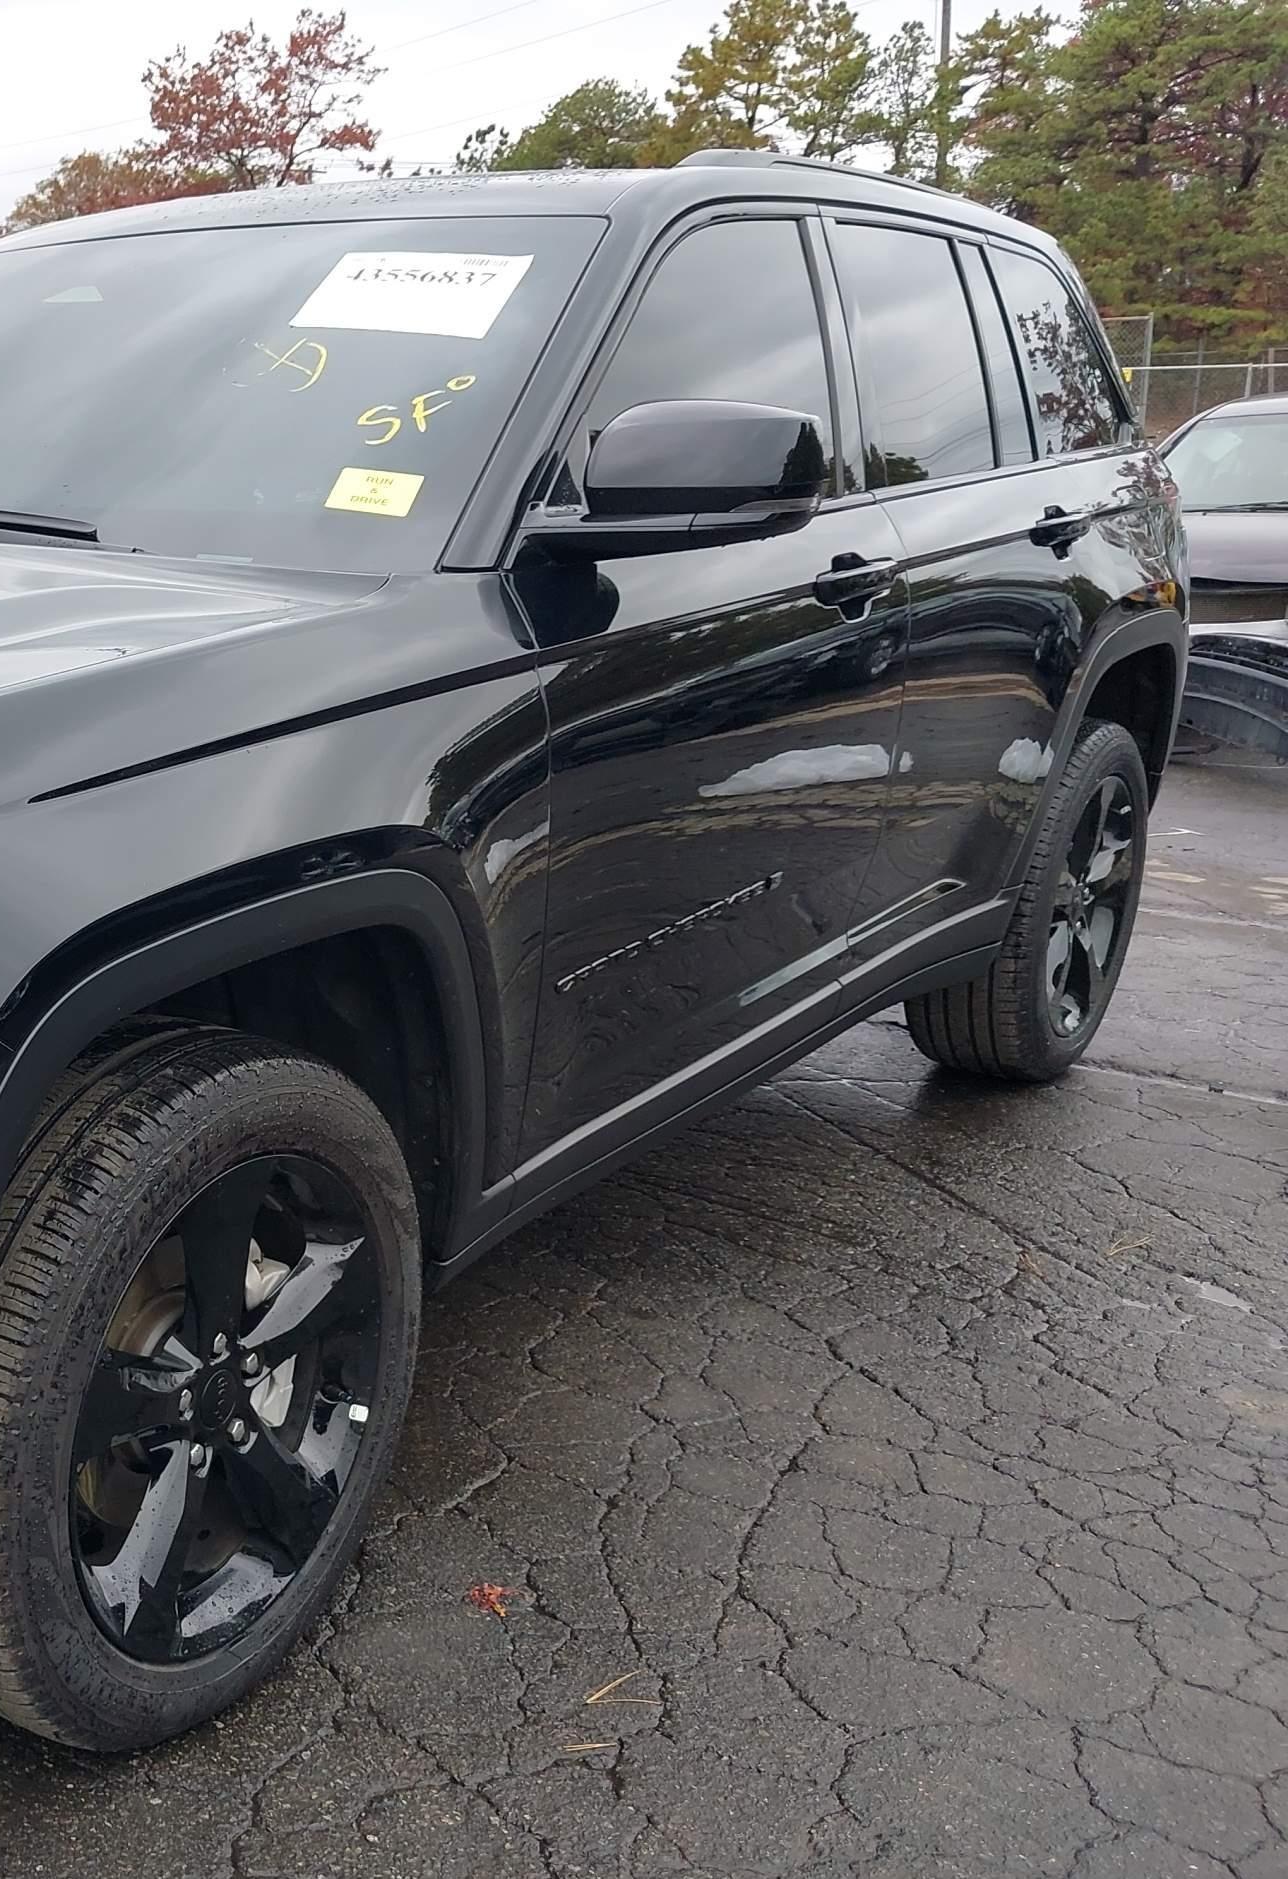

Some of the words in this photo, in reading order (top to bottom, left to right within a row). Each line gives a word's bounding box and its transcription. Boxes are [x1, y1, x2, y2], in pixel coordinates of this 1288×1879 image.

[346, 267, 498, 287] 43556837
[366, 475, 394, 486] RUN
[349, 495, 390, 506] DRIVE
